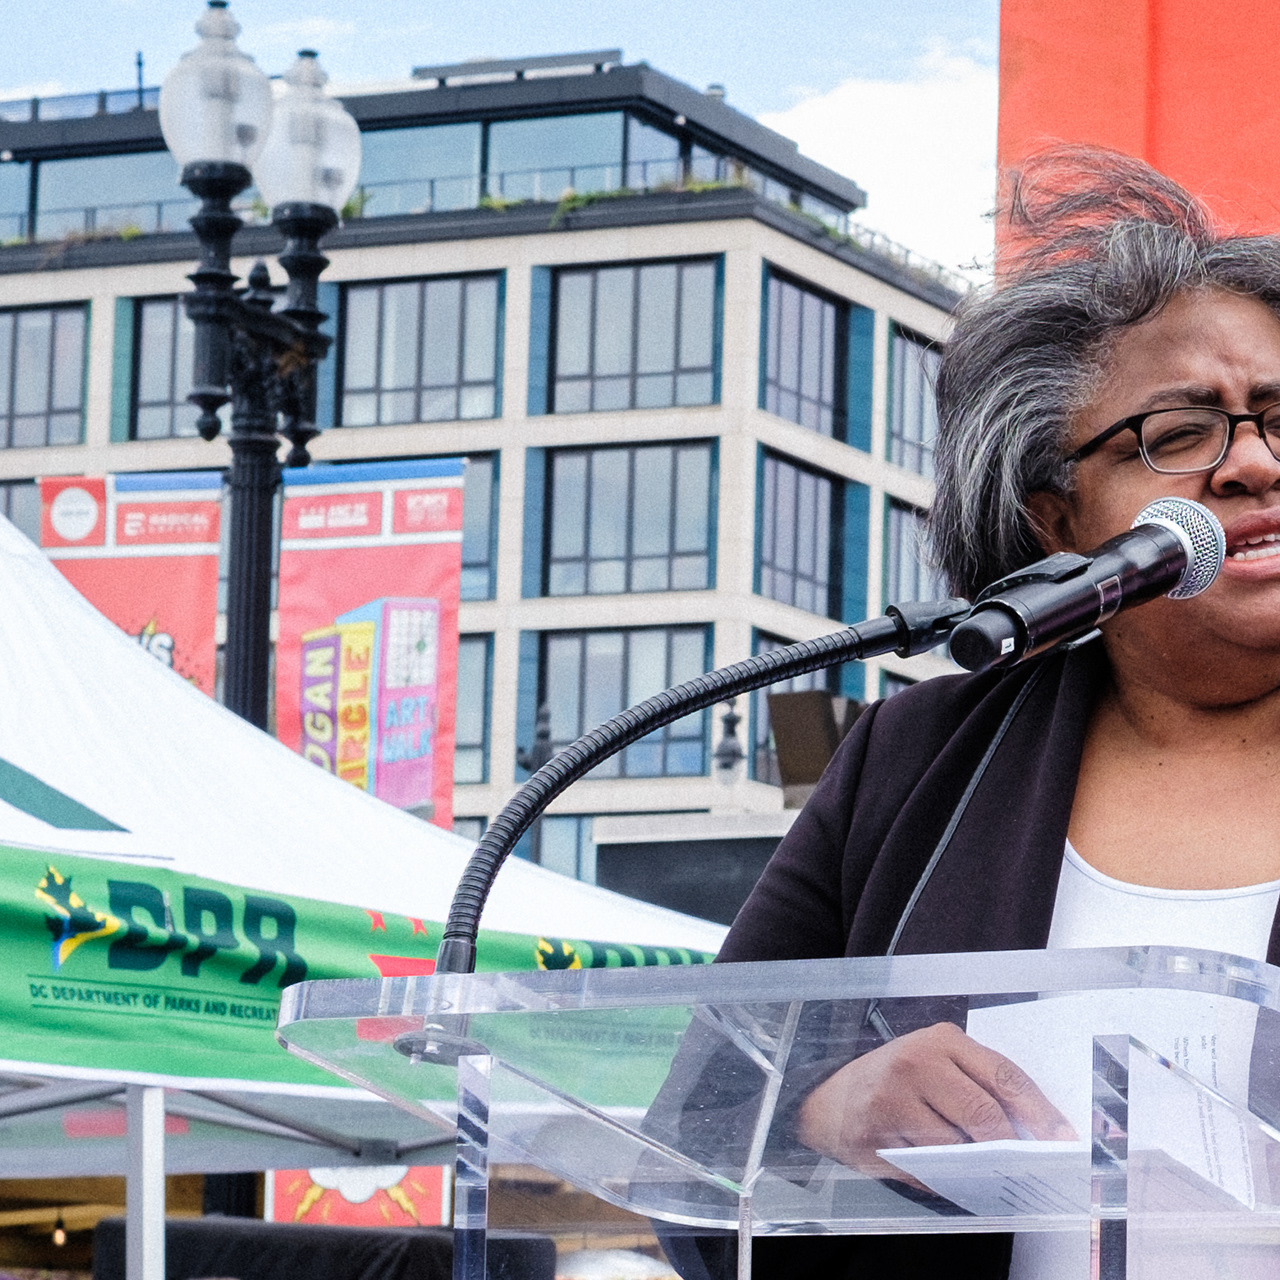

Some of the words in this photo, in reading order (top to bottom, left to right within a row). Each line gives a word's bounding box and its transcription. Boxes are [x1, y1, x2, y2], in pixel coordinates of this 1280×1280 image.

[303, 645, 336, 772] OGAN
[338, 645, 370, 786] IRCLE
[385, 696, 429, 729] ART
[107, 879, 308, 988] DPR
[29, 982, 48, 999] DC
[51, 985, 138, 1007] DEPARTMENT
[142, 993, 160, 1009] OF
[164, 996, 200, 1014] PARKS
[204, 1000, 227, 1016] AND
[230, 1003, 278, 1021] RECREAT
